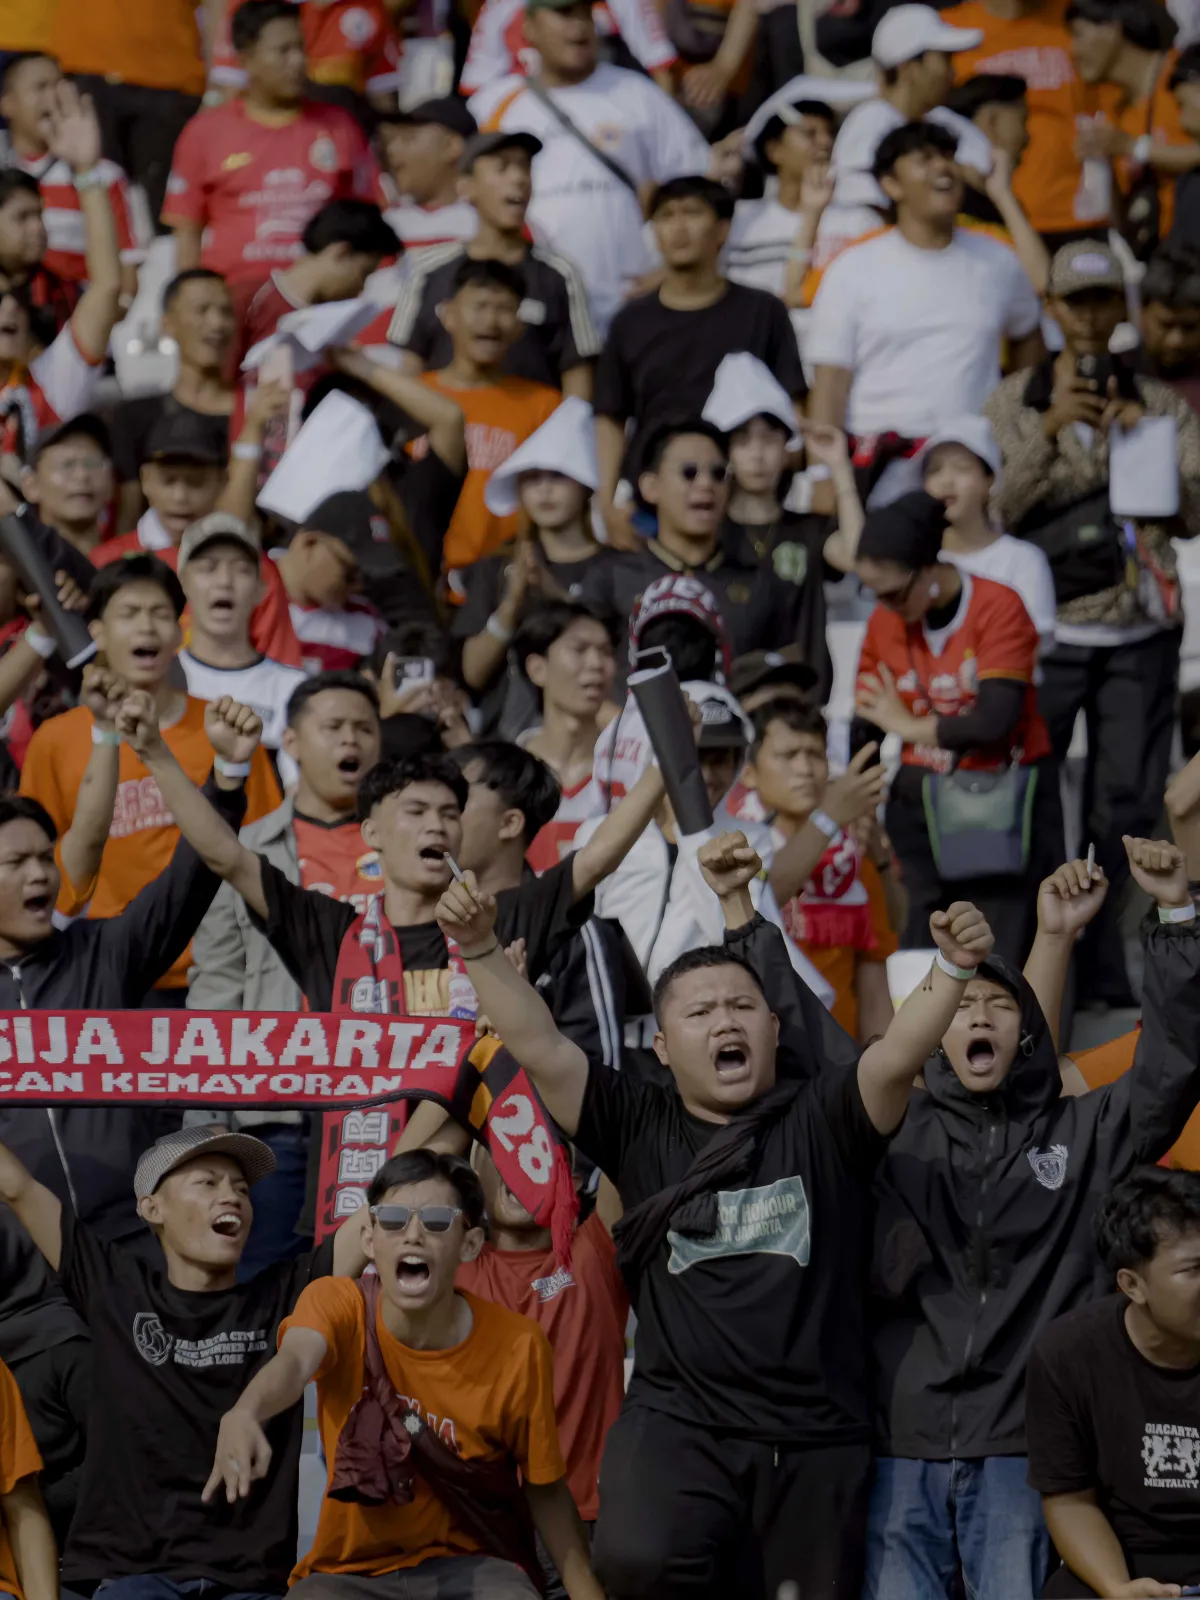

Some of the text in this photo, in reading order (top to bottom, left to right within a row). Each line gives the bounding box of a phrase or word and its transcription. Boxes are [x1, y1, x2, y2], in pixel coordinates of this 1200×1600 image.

[141, 1016, 462, 1069] JAKARTA
[101, 1072, 403, 1096] KEMAYORAN
[489, 1093, 554, 1185] 28
[741, 1193, 797, 1225] HONOUR
[734, 1218, 783, 1243] JAKARTA
[1143, 1476, 1200, 1489] MENTALITY
